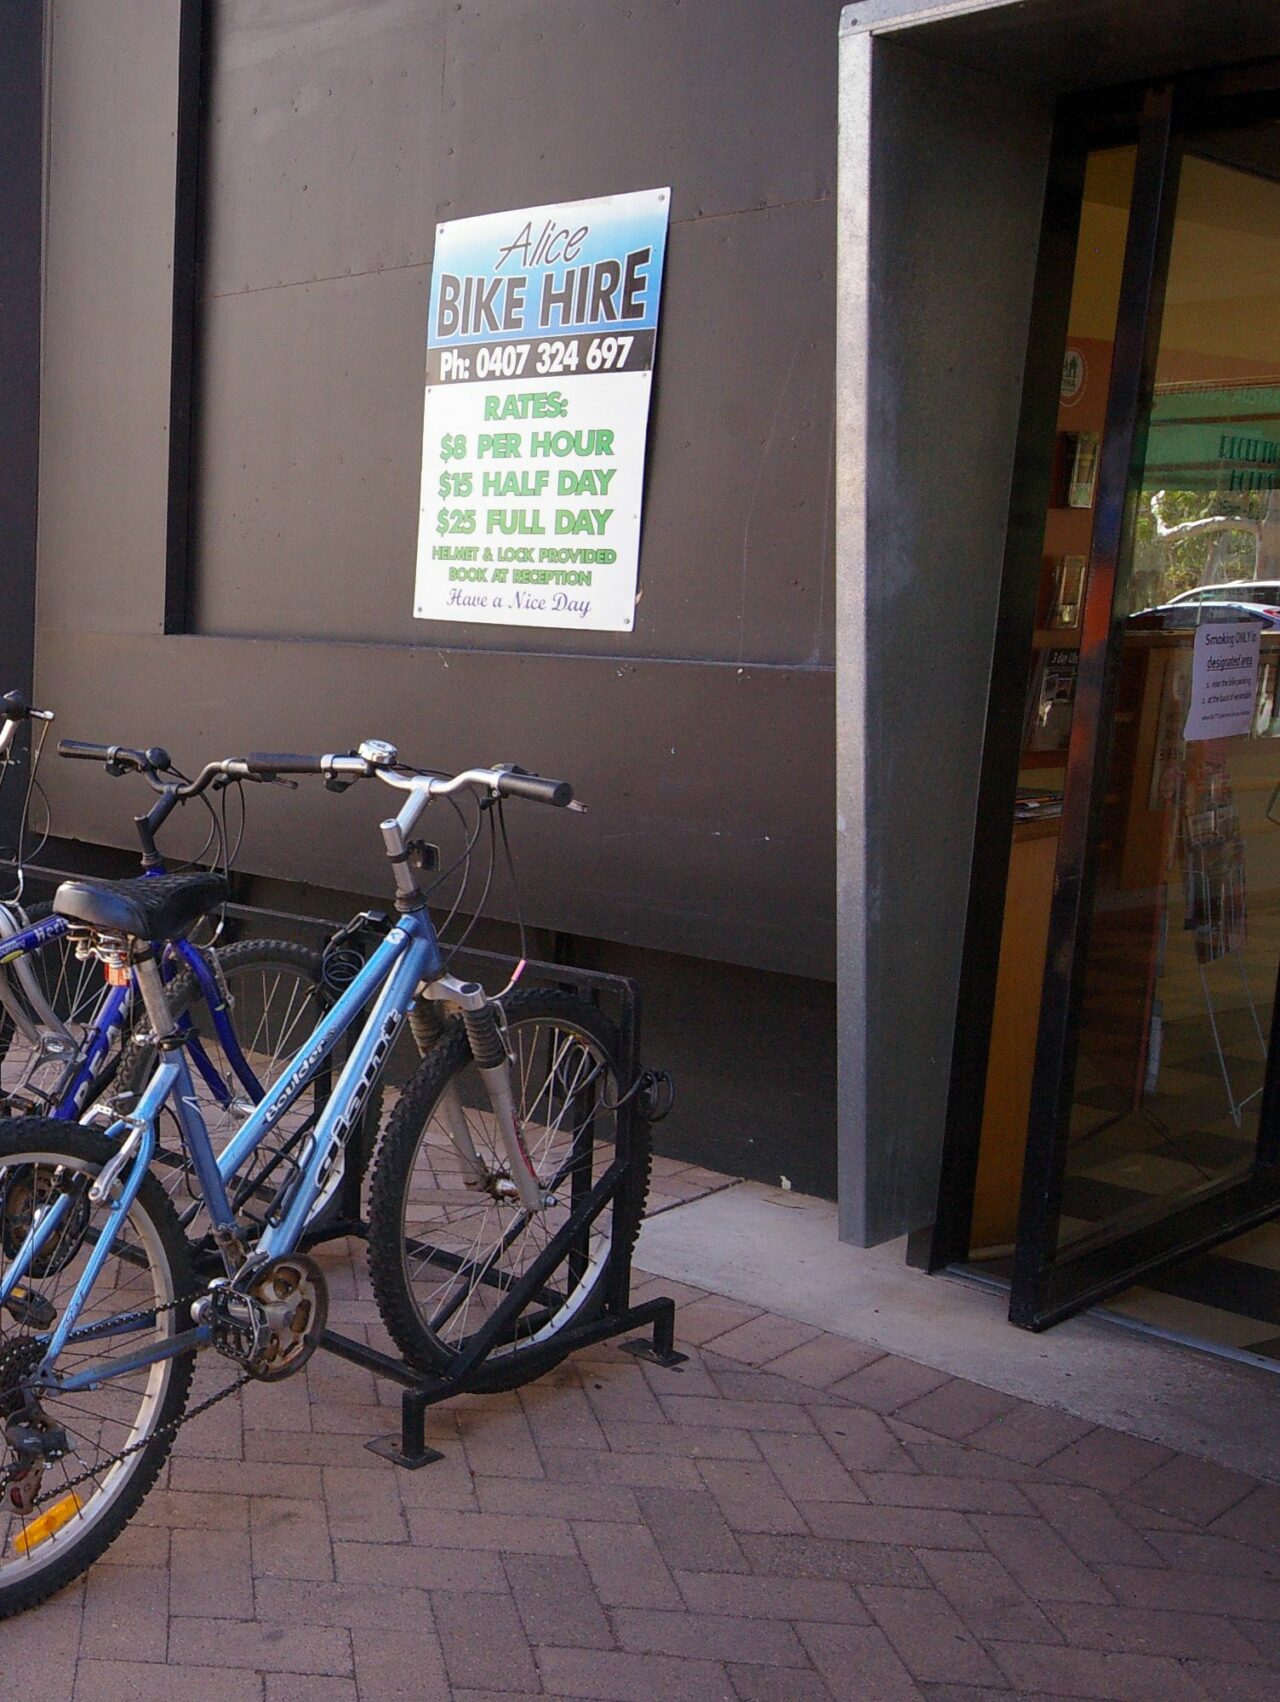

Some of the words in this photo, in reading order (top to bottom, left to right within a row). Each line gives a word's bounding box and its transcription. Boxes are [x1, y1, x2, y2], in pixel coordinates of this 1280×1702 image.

[495, 219, 589, 270] Alice
[435, 272, 528, 339] BIKE
[538, 245, 653, 329] HIRE
[439, 349, 470, 381] Ph:
[475, 344, 531, 379] 0407
[536, 340, 579, 374] 324
[586, 336, 634, 371] 697
[484, 391, 569, 422] RATES:
[439, 433, 467, 464] $8
[477, 432, 522, 460] PER
[530, 429, 615, 457] HOUR
[438, 470, 473, 501] $15
[481, 470, 550, 497] HALF
[557, 469, 618, 496] DAY
[435, 507, 477, 538] $25
[486, 508, 546, 535] FULL
[554, 508, 615, 536] DAY
[431, 545, 480, 561] HELMET
[481, 547, 494, 562] &
[497, 547, 535, 563] LOCK
[538, 548, 617, 565] PROVIDED
[448, 566, 488, 582] BOOK
[491, 568, 509, 583] AT
[512, 569, 593, 587] RECEPTION
[446, 588, 488, 608] Have
[492, 596, 503, 608] a
[508, 591, 546, 611] Nice
[552, 592, 592, 619] Day
[1205, 631, 1235, 648] Smoking
[34, 916, 69, 942] Heri
[264, 1038, 328, 1124] Boulder
